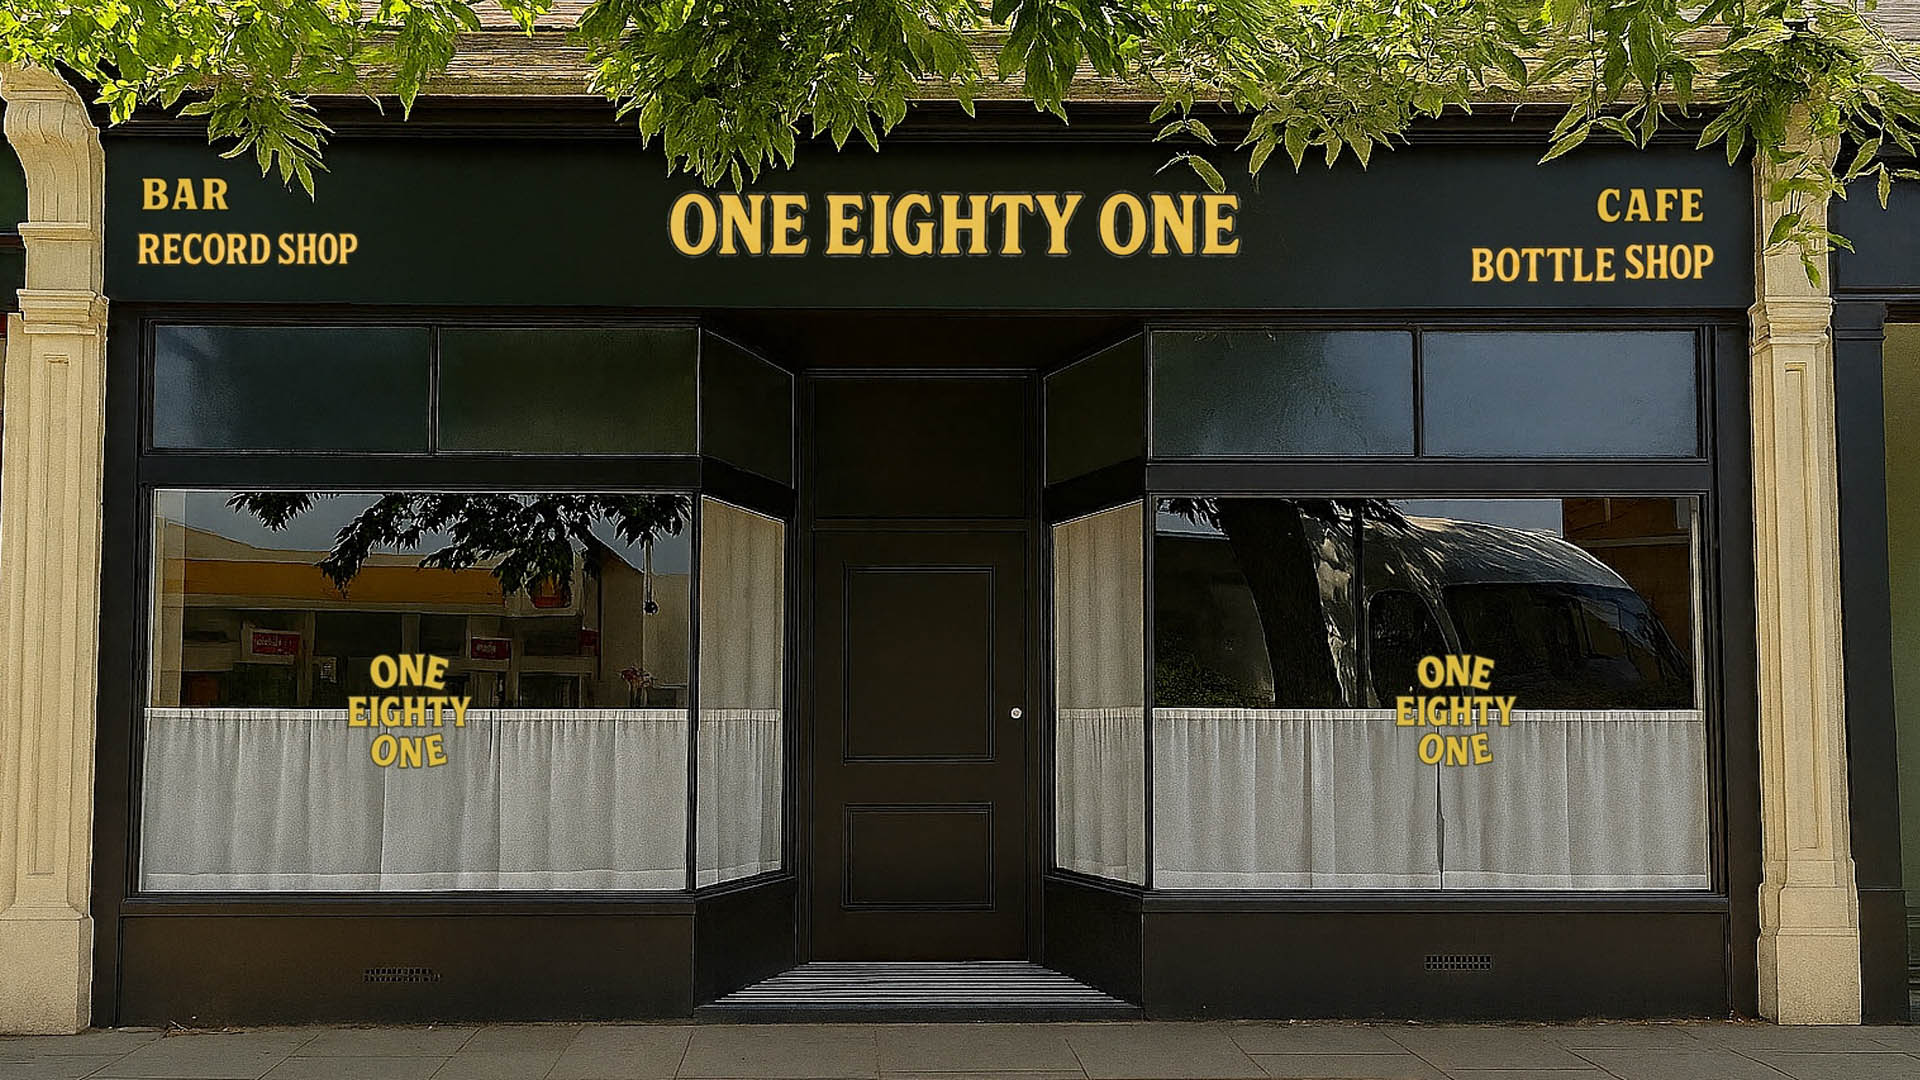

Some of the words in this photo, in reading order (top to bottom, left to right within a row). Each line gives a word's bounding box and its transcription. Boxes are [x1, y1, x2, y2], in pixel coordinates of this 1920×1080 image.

[142, 178, 228, 210] BAR
[1597, 188, 1704, 223] CAFE
[669, 193, 809, 257] ONE
[825, 193, 1084, 257] EIGHTY
[1098, 193, 1241, 257] ONE
[137, 233, 271, 266] RECORD
[278, 233, 358, 265] SHOP
[1471, 247, 1616, 283] BOTTLE
[1625, 244, 1714, 280] SHOP
[370, 653, 450, 690] ONE
[1417, 654, 1496, 690] ONE
[348, 695, 472, 728] EIGHTY
[1396, 695, 1517, 727] EIGHTY
[370, 733, 448, 769] ONE
[1418, 732, 1494, 766] ONE
